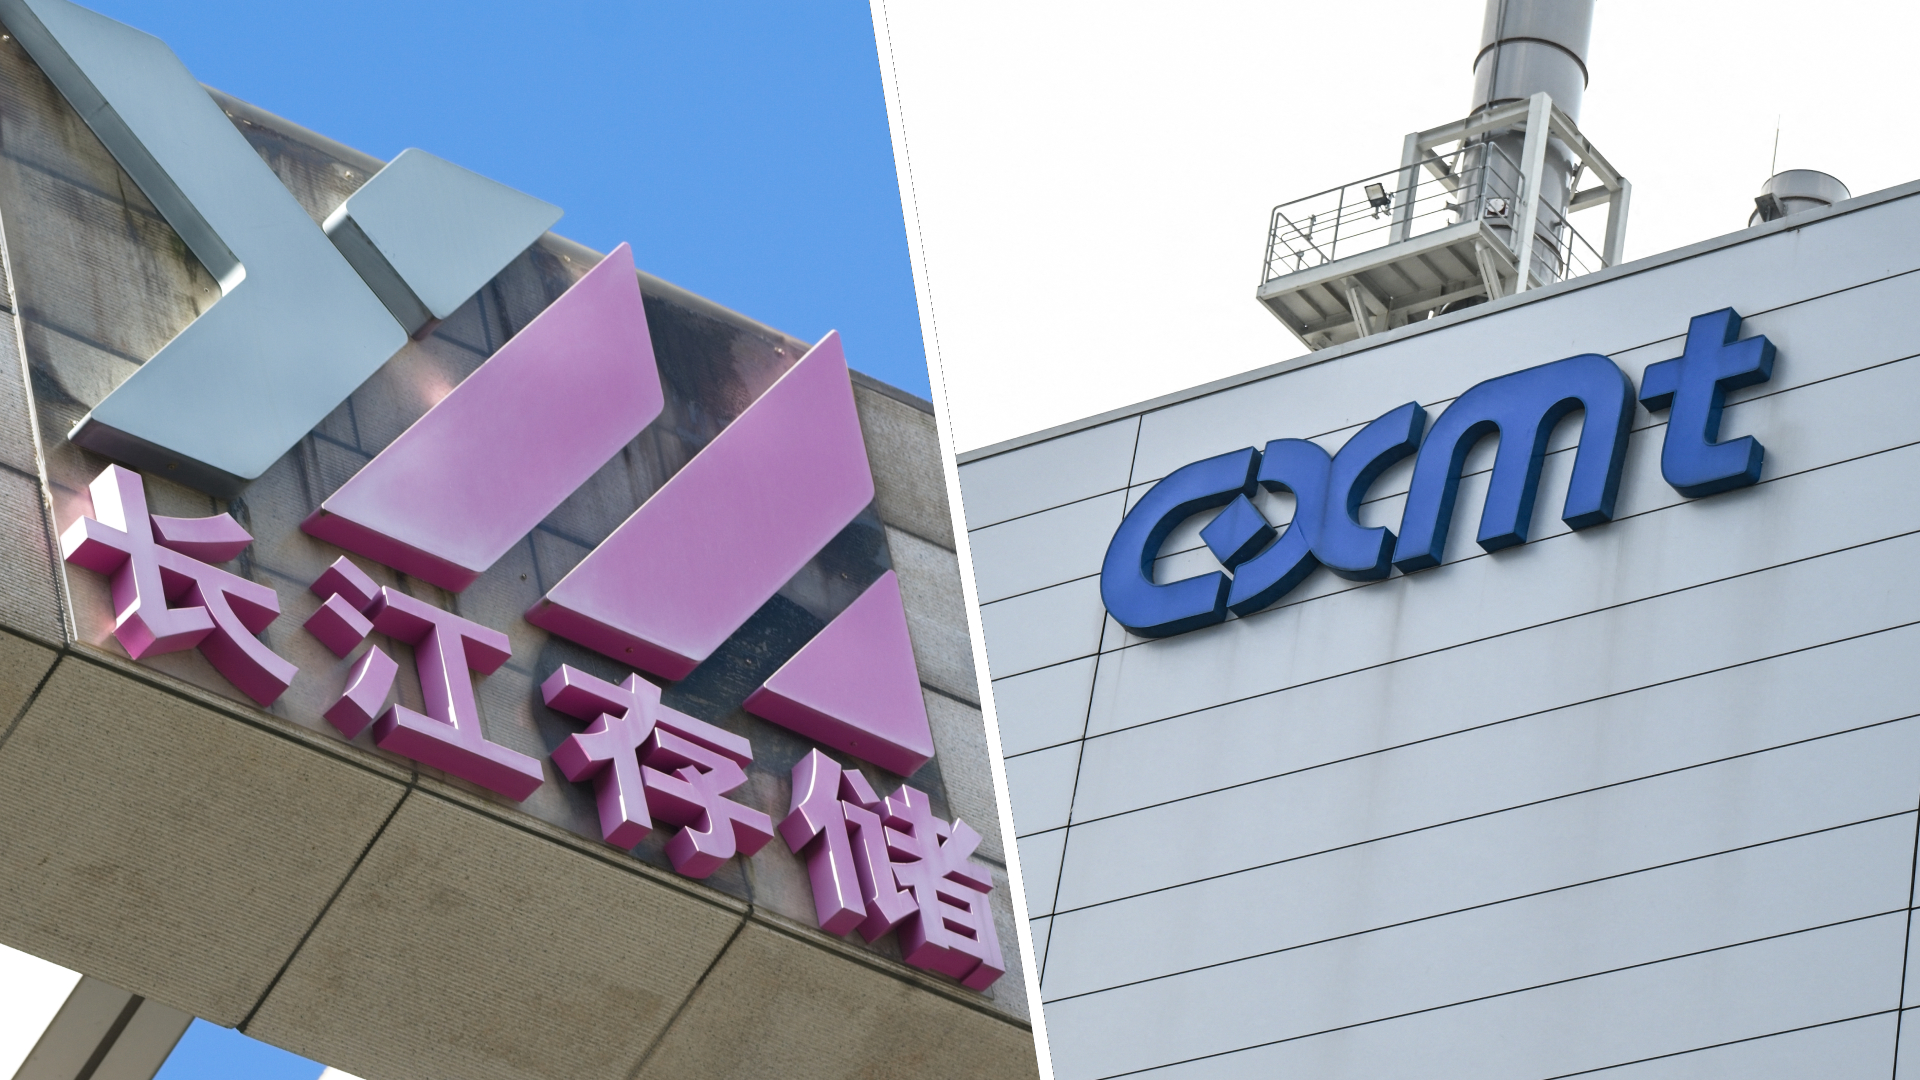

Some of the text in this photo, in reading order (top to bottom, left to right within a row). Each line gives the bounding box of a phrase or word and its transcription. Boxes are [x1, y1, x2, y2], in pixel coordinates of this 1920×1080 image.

[1100, 306, 1776, 638] cxmt
[61, 463, 1005, 992] 长江存储
